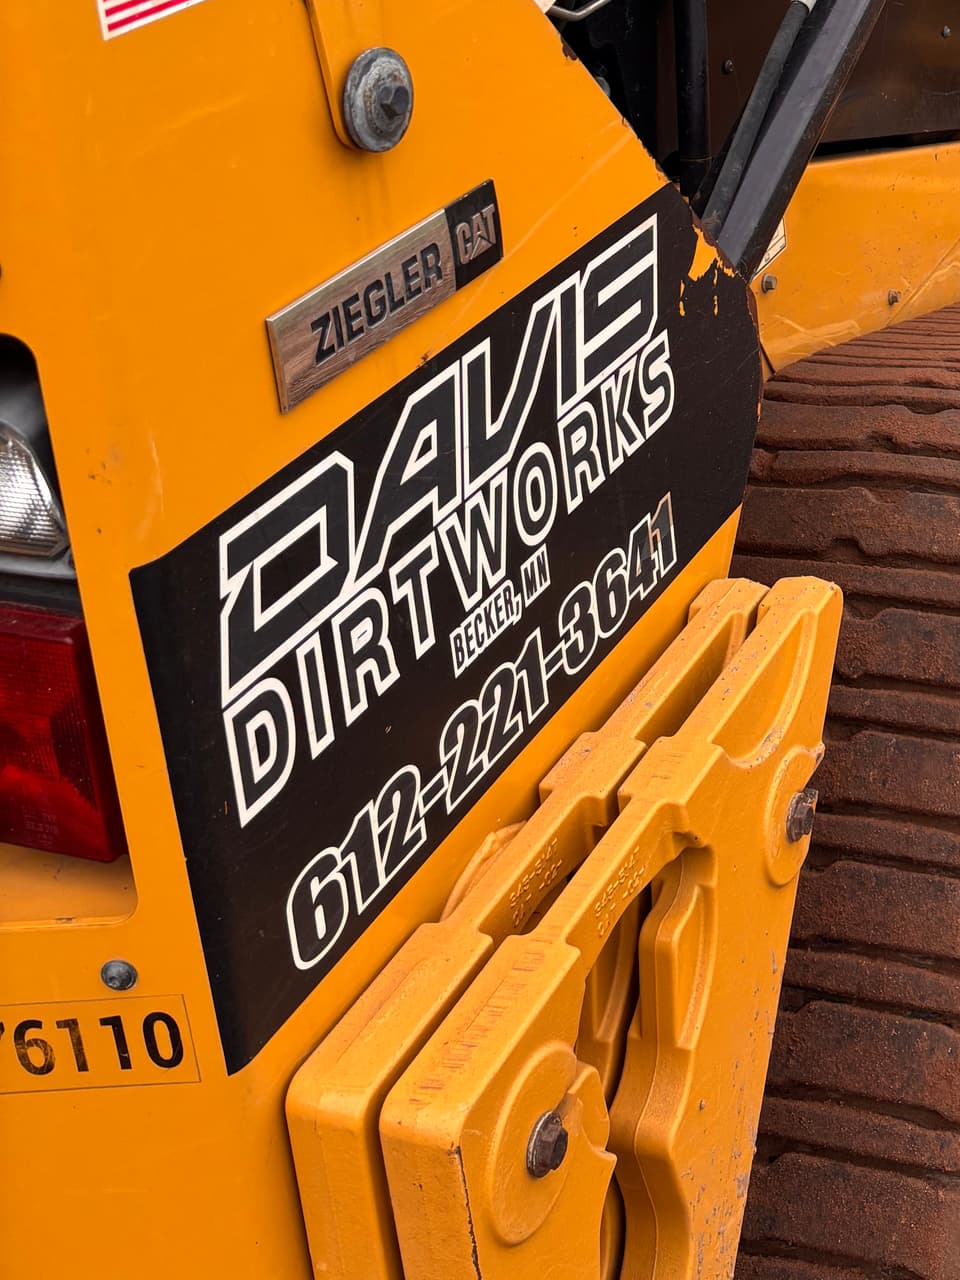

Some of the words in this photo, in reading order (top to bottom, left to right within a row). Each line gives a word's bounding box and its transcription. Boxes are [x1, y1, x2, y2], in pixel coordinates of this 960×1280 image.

[309, 242, 444, 368] ZIEGLER
[455, 203, 497, 265] CAT
[218, 213, 659, 708] DAVIS
[449, 579, 523, 679] BECKER,
[520, 543, 551, 609] MN
[286, 491, 678, 970] 612-221-3641
[0, 1011, 184, 1076] 6110
